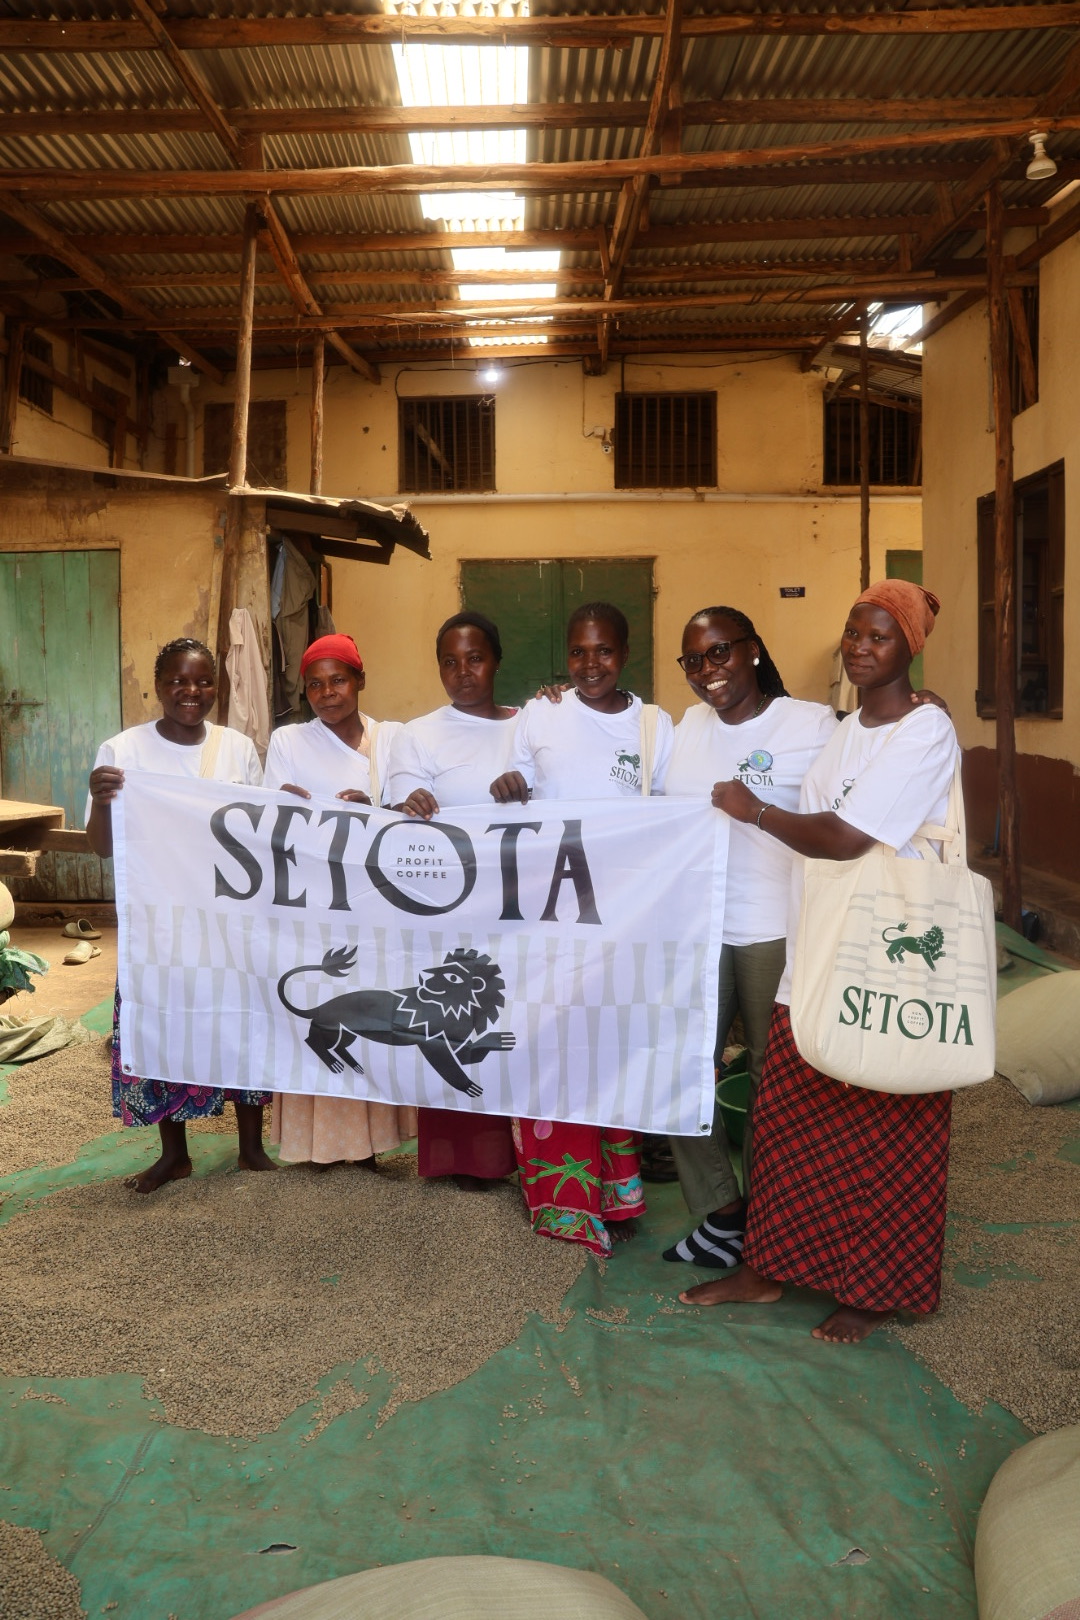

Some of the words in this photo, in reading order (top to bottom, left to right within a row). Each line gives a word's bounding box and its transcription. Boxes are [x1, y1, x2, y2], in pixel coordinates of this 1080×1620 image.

[609, 765, 639, 787] SETOTA
[408, 844, 435, 852] NON
[210, 801, 603, 926] SETOTA
[397, 857, 443, 866] PROFIT
[396, 870, 447, 879] COFFEE
[838, 985, 974, 1046] SETOTA
